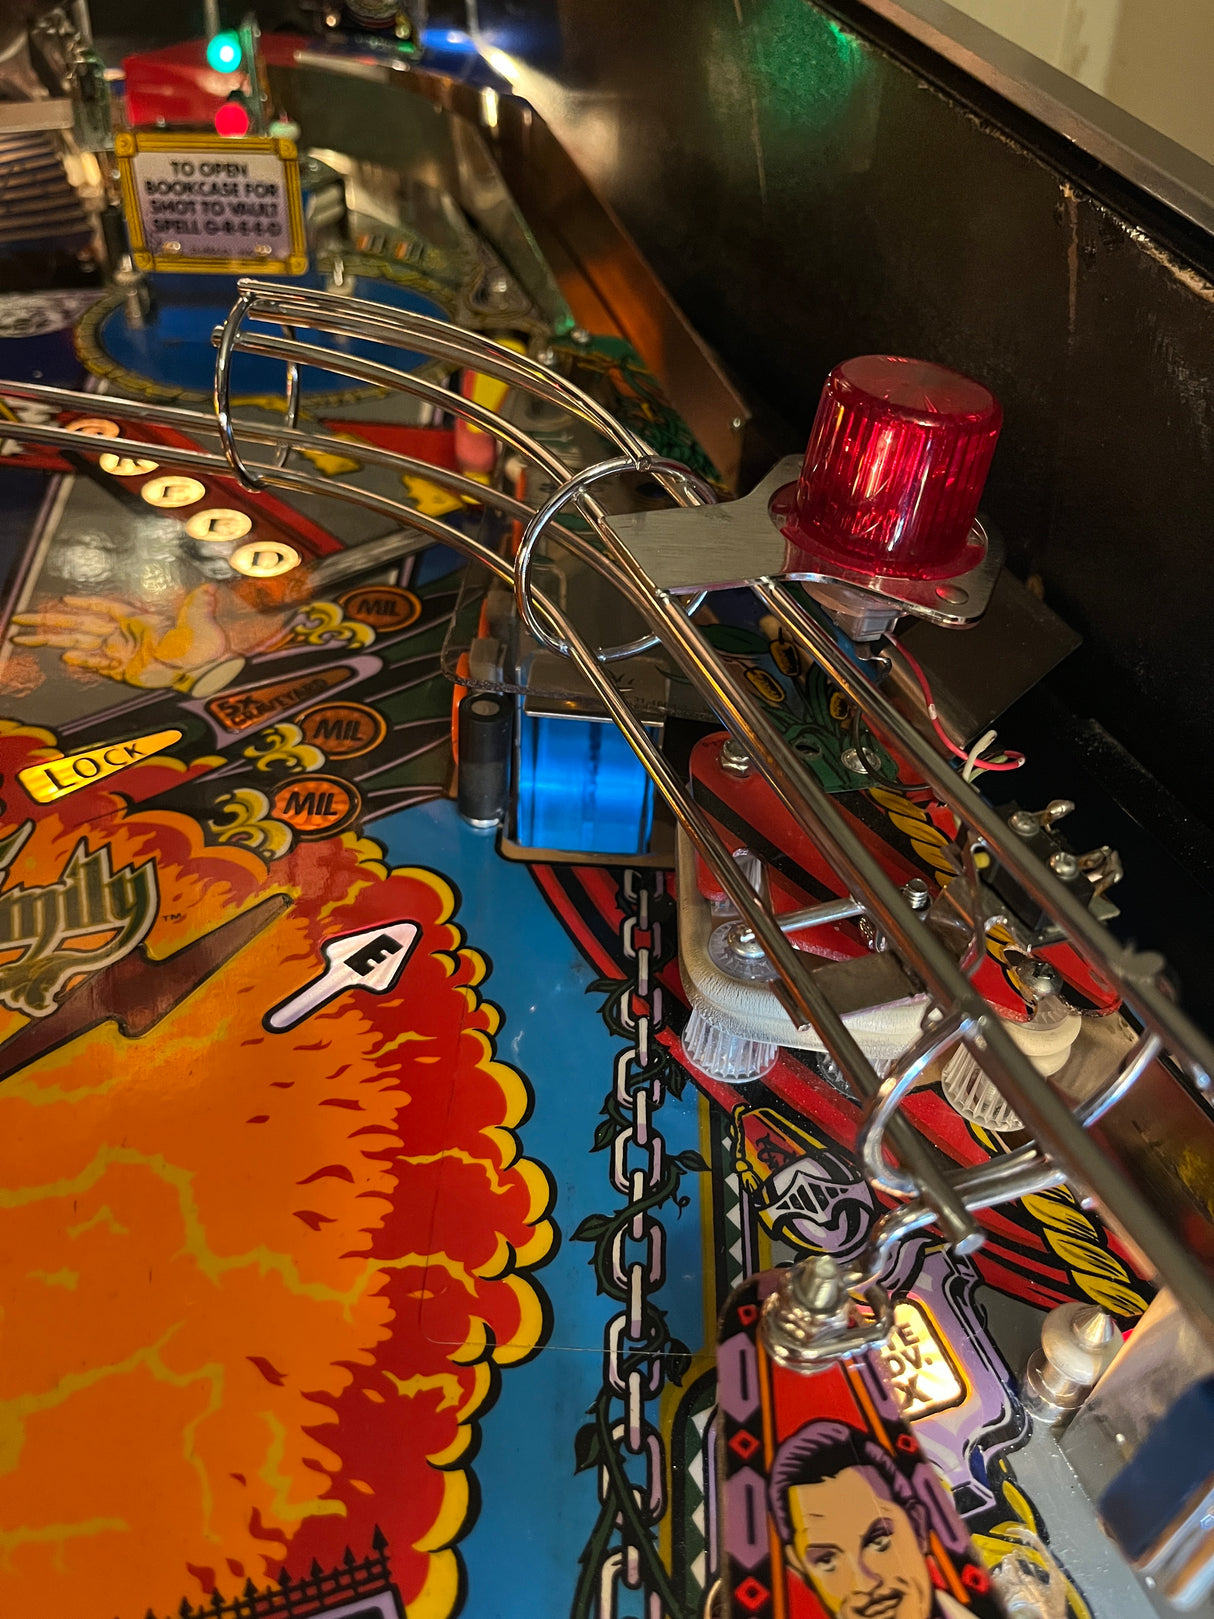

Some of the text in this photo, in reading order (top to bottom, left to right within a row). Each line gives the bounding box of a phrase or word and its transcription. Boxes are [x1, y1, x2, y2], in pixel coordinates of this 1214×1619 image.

[171, 161, 248, 177] TO OPEN
[146, 181, 278, 198] BOOKCASE FOR
[152, 200, 196, 215] SHOT
[202, 201, 225, 216] TO
[154, 219, 199, 235] SPELL
[357, 597, 402, 618] MIL
[313, 720, 365, 745] MIL
[44, 741, 149, 792] LOCK
[282, 791, 339, 817] MIL
[343, 933, 404, 976] E
[886, 1345, 933, 1377] DV.
